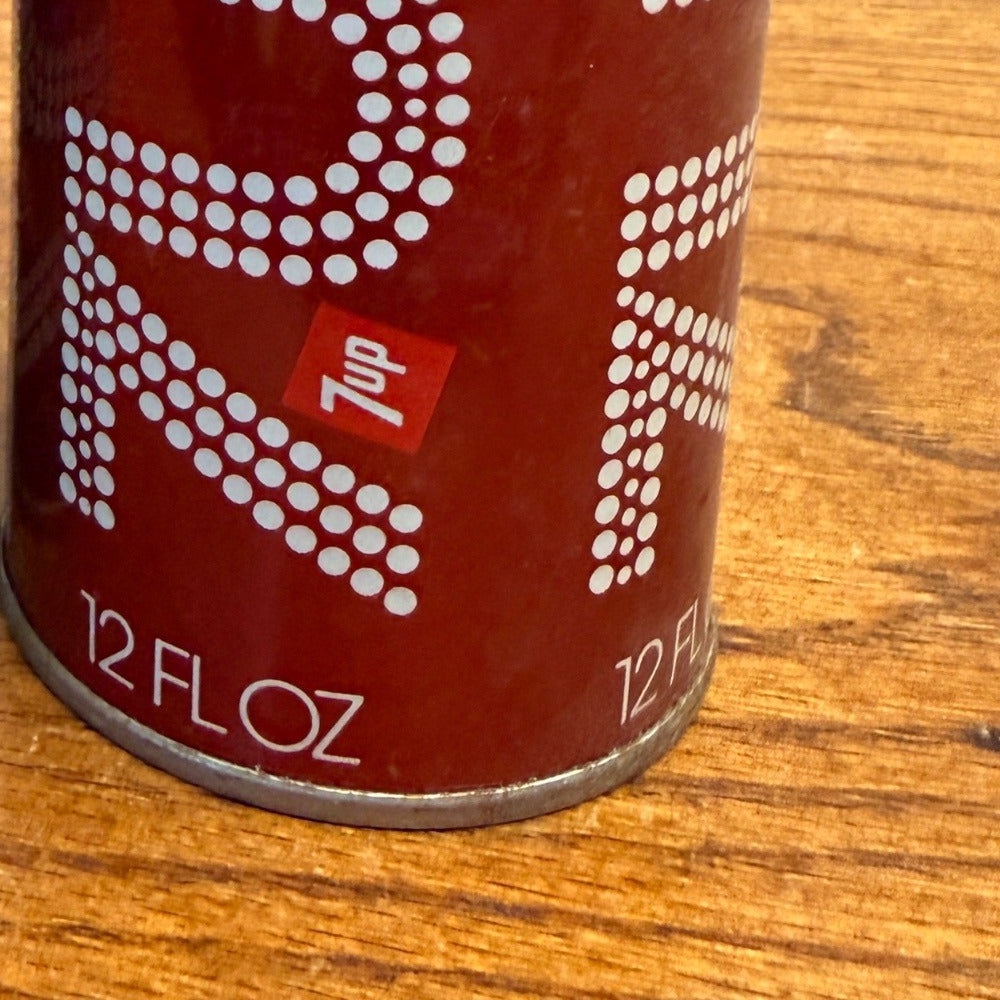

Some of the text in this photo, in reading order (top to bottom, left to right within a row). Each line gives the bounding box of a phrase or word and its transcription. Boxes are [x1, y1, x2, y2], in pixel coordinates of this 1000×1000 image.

[80, 589, 364, 765] 12 FL OZ
[615, 638, 663, 726] 12
